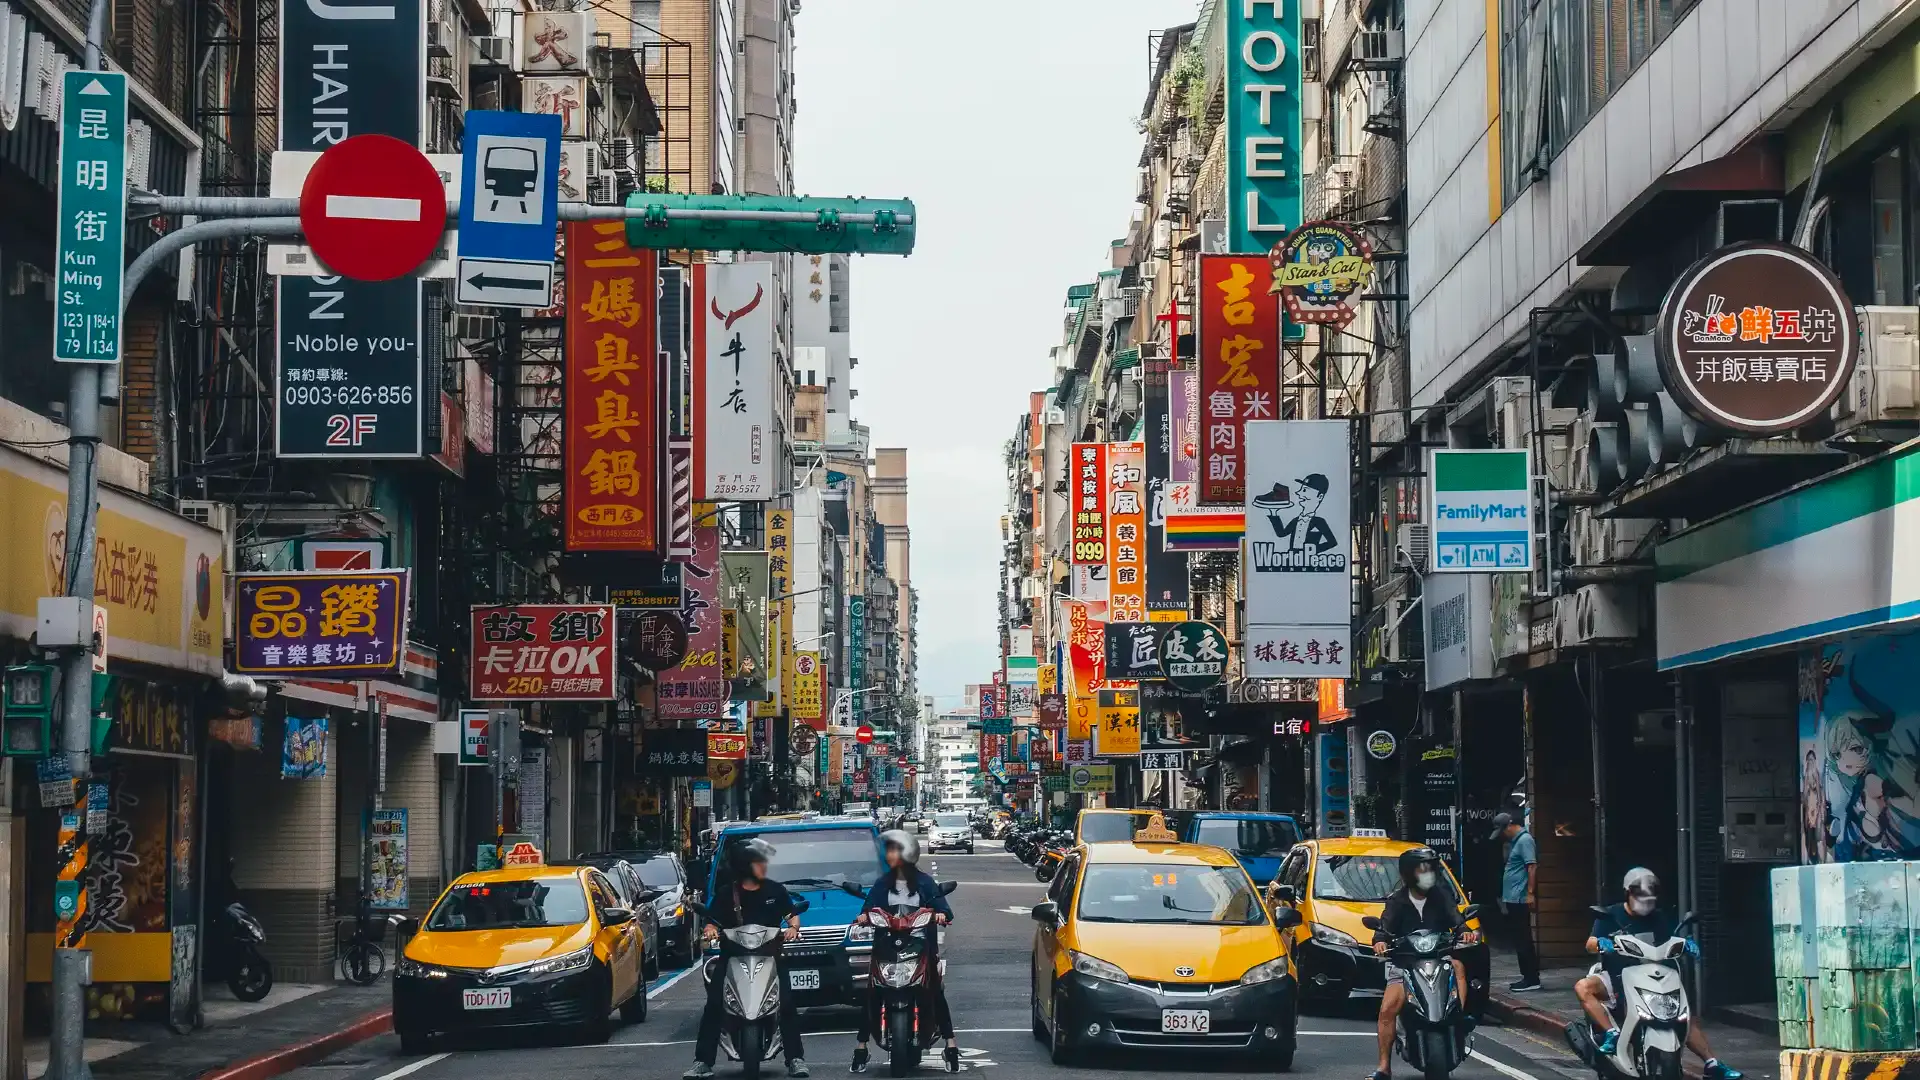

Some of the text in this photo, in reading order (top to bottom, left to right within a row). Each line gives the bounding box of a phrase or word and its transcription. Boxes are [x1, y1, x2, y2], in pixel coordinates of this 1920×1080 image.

[313, 44, 349, 145] HAIR
[74, 108, 110, 242] 昆明街
[64, 251, 96, 266] Kun
[64, 271, 103, 289] Ming
[64, 291, 84, 305] St.
[63, 313, 83, 328] 123
[93, 314, 115, 329] 184-1
[1216, 263, 1264, 388] 吉宏
[64, 339, 81, 353] 79
[1693, 334, 1733, 342] DonMono
[93, 340, 114, 355] 134
[580, 222, 641, 498] 三媽臭臭鍋
[1695, 357, 1827, 383] 丼飯專賣店
[286, 386, 413, 405] 0903-626-856
[326, 413, 378, 446] 2F
[1159, 414, 1169, 453] 日本食堂
[1208, 390, 1237, 482] 魯肉飯
[714, 483, 760, 494] 2389-5577
[1081, 448, 1097, 511] 泰式按摩
[1169, 484, 1190, 505] 彩
[586, 507, 637, 523] 西門店
[1077, 511, 1102, 524] 指壓
[1177, 505, 1221, 513] RAINBOW
[1437, 504, 1527, 522] FamilyMart
[1075, 525, 1104, 540] 2小時
[1075, 541, 1105, 561] 999
[1472, 548, 1495, 562] ATM
[250, 583, 379, 639] 晶鑽
[1149, 601, 1187, 609] TAKUMI
[481, 611, 604, 643] 故鄉
[641, 615, 657, 652] 西門
[1070, 605, 1088, 645] 足ツボ
[262, 642, 381, 665] 音樂餐坊 B1
[1129, 635, 1159, 669] 匠
[1165, 629, 1226, 663] 皮衣
[1253, 639, 1344, 665] 球鞋專賣
[478, 645, 607, 675] 卡拉OK
[1087, 628, 1105, 695] マッサージ
[659, 682, 689, 699] 按摩
[693, 702, 717, 714] 999
[468, 737, 489, 745] ELEV
[1144, 753, 1179, 768] 菸酒
[1425, 823, 1452, 831] BURGE
[517, 845, 532, 855] M
[507, 855, 540, 865] 大都會
[464, 991, 511, 1007] TDD-1717
[1164, 1015, 1208, 1030] 363-K2
